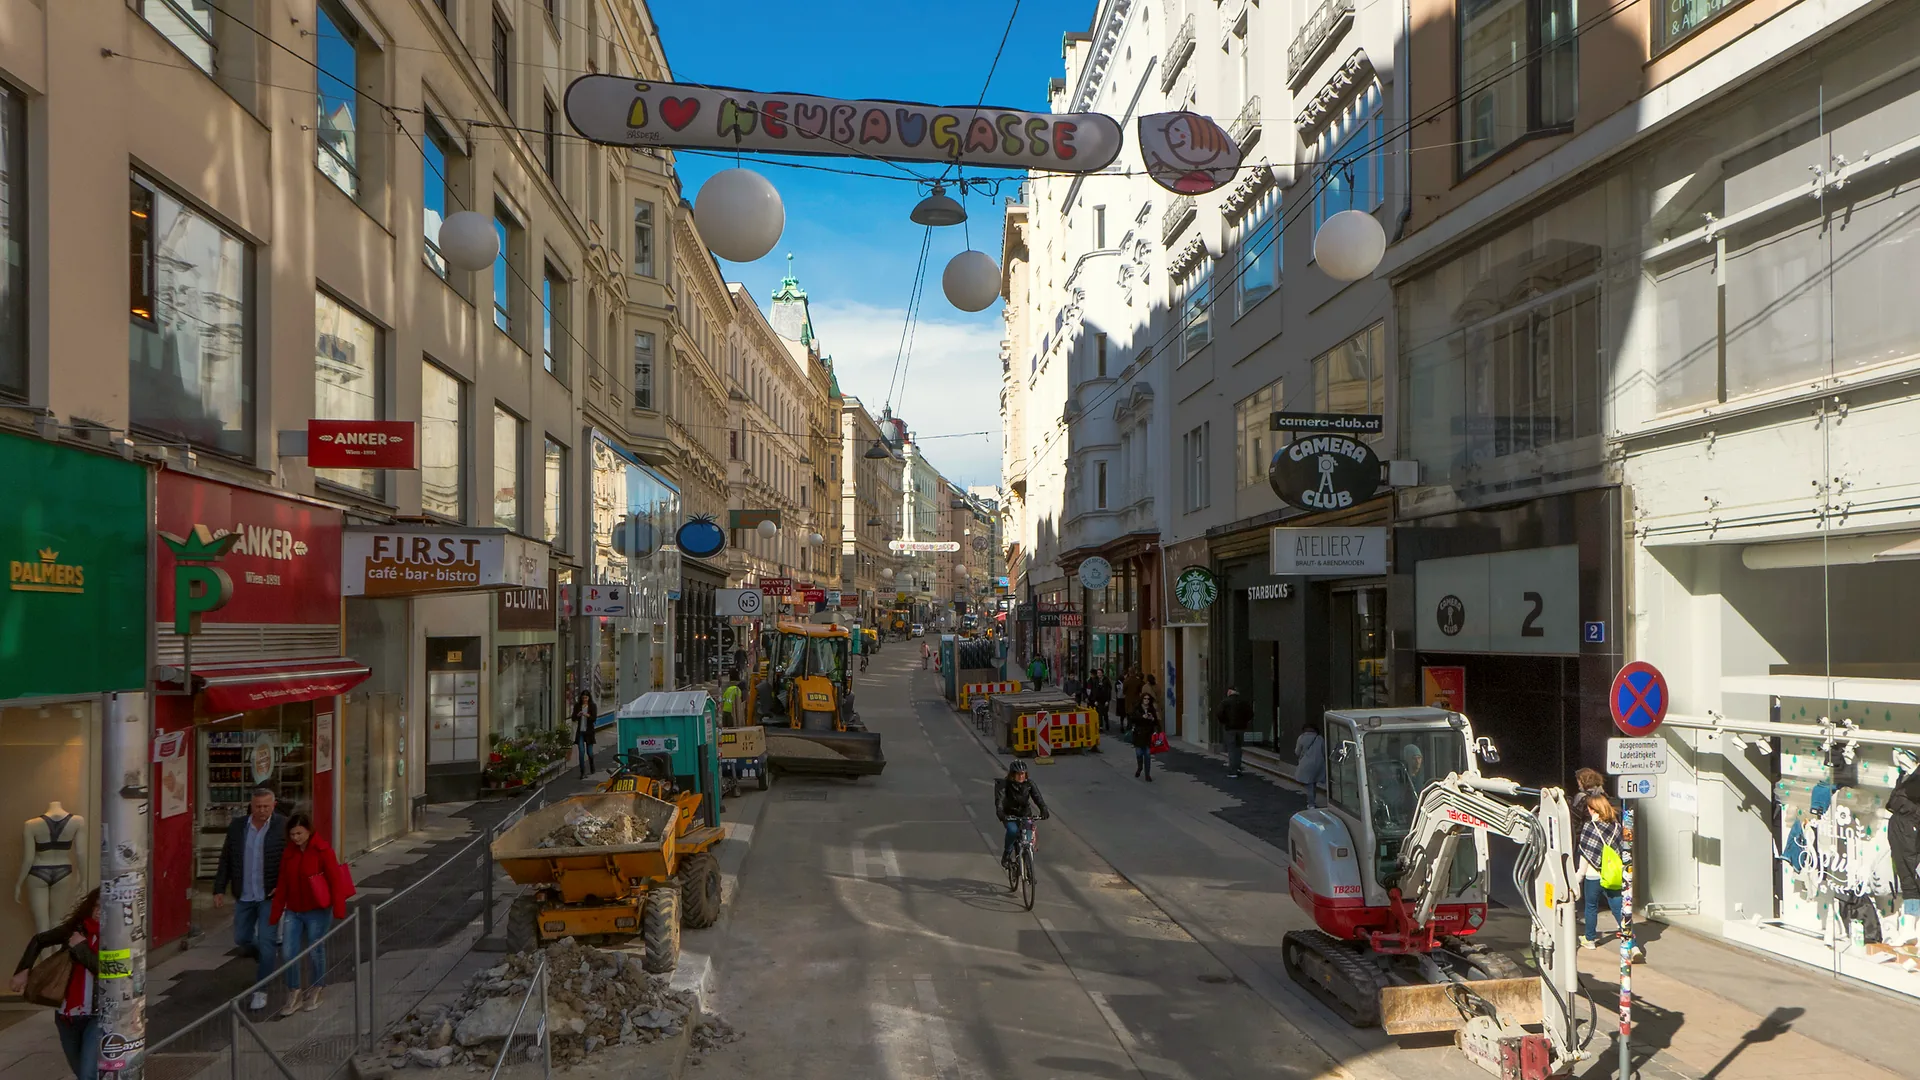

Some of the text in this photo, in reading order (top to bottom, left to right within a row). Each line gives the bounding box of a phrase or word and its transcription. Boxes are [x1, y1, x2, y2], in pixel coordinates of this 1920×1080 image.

[716, 97, 1077, 161] NEUBAUGASSE
[1279, 417, 1379, 429] camera-club.at
[334, 432, 387, 445] ANKER
[1289, 437, 1367, 464] CAMERA
[1301, 489, 1353, 509] CLUB
[232, 522, 293, 560] ANKER
[1296, 536, 1365, 556] ATELIER 7
[372, 535, 481, 566] FIRST
[10, 560, 84, 586] PALMERS
[368, 567, 477, 582] café bar bistro
[505, 588, 549, 610] BLUMEN
[1248, 583, 1288, 600] STARBUCKS
[1439, 597, 1462, 612] CAMERA
[1521, 591, 1544, 637] 2
[1443, 624, 1458, 635] CLUB
[1590, 625, 1598, 638] 2
[1619, 742, 1658, 750] ausgenommen
[1620, 751, 1656, 760] Ladetätigkeit
[1610, 761, 1629, 769] Mo.-Fr.
[1333, 885, 1361, 894] TB230
